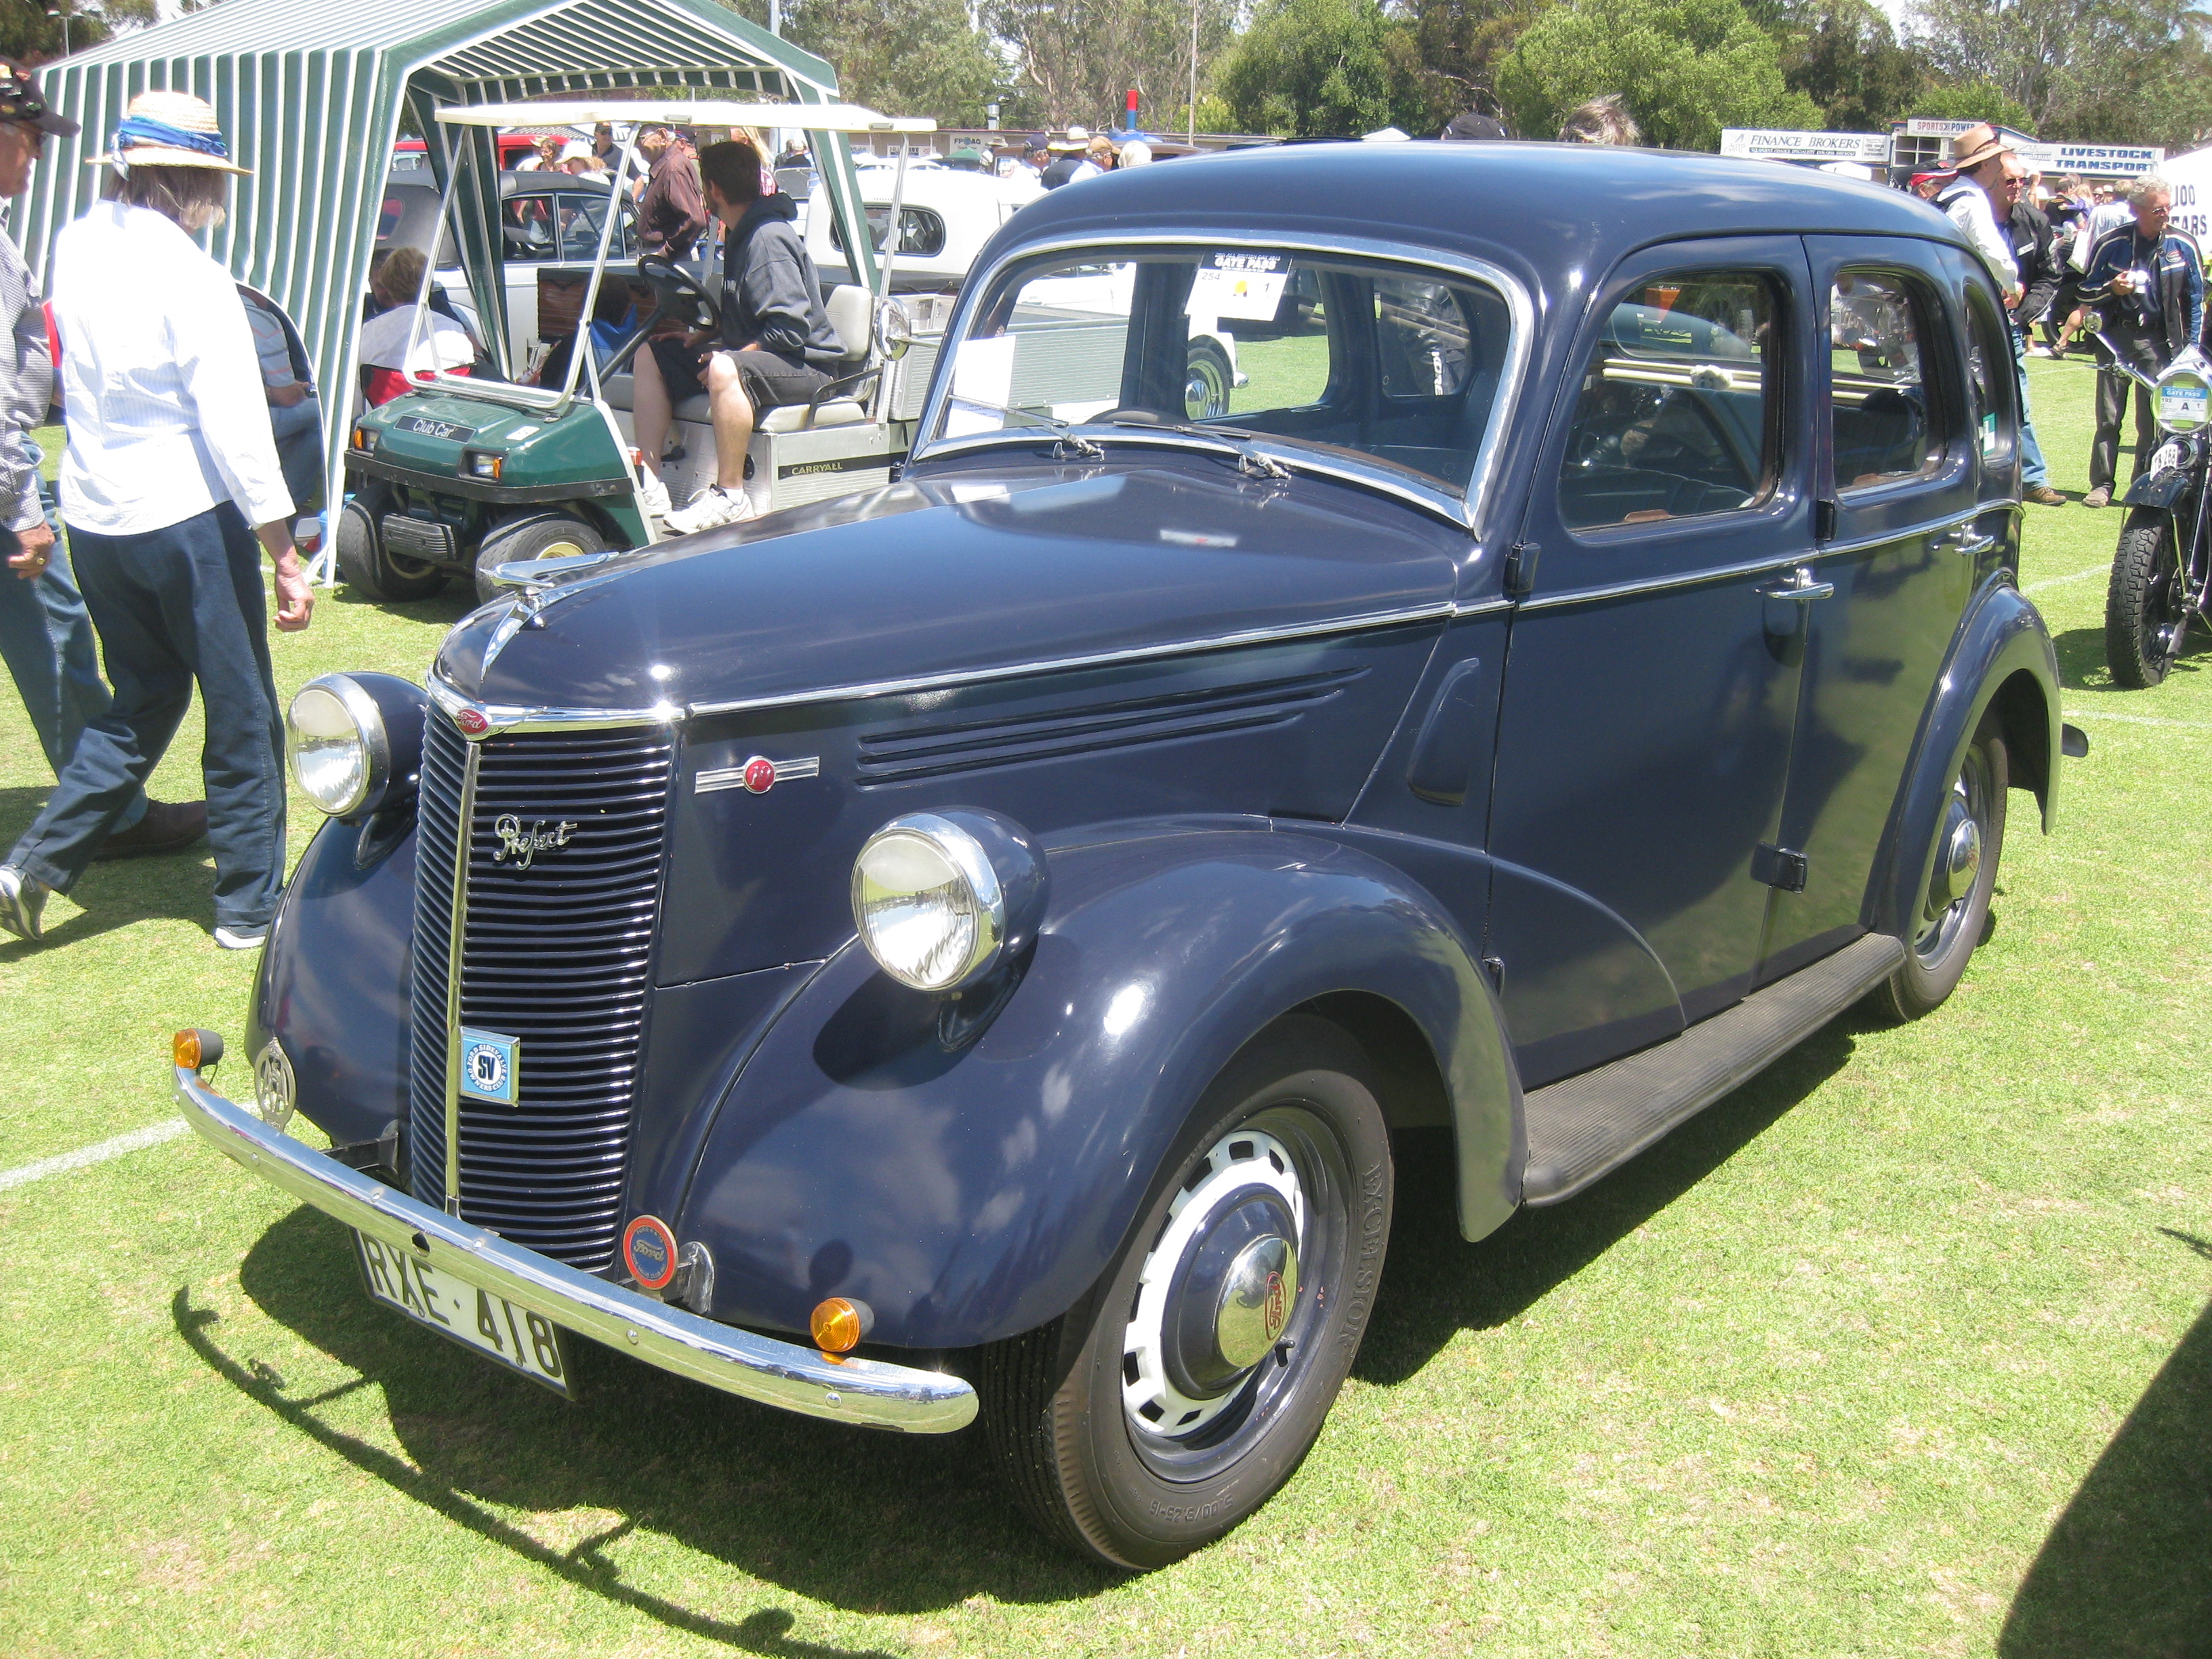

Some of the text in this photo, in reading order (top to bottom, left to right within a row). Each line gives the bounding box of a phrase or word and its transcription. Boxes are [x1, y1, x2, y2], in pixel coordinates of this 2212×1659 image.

[1917, 121, 1944, 131] SPORTS
[1750, 135, 1802, 146] FINANCE
[1807, 136, 1861, 149] BROKERS
[2061, 147, 2153, 159] LIVESTOCK
[2055, 159, 2154, 172] TRANSPORT
[2175, 184, 2196, 207] 100
[1214, 257, 1245, 268] GATE
[1246, 258, 1277, 270] PASS
[1202, 272, 1221, 281] 254
[2180, 402, 2190, 411] A
[413, 419, 454, 438] Club Car
[792, 462, 843, 475] CARRYALL
[457, 712, 483, 729] Ford
[466, 1044, 507, 1074] FORD SIDEVALVE
[478, 1054, 495, 1081] SV
[468, 1069, 506, 1091] OWNERS CLUB
[633, 1240, 664, 1262] Ford
[1336, 1161, 1383, 1349] EXCELSIOR
[1269, 1280, 1282, 1330] Ford
